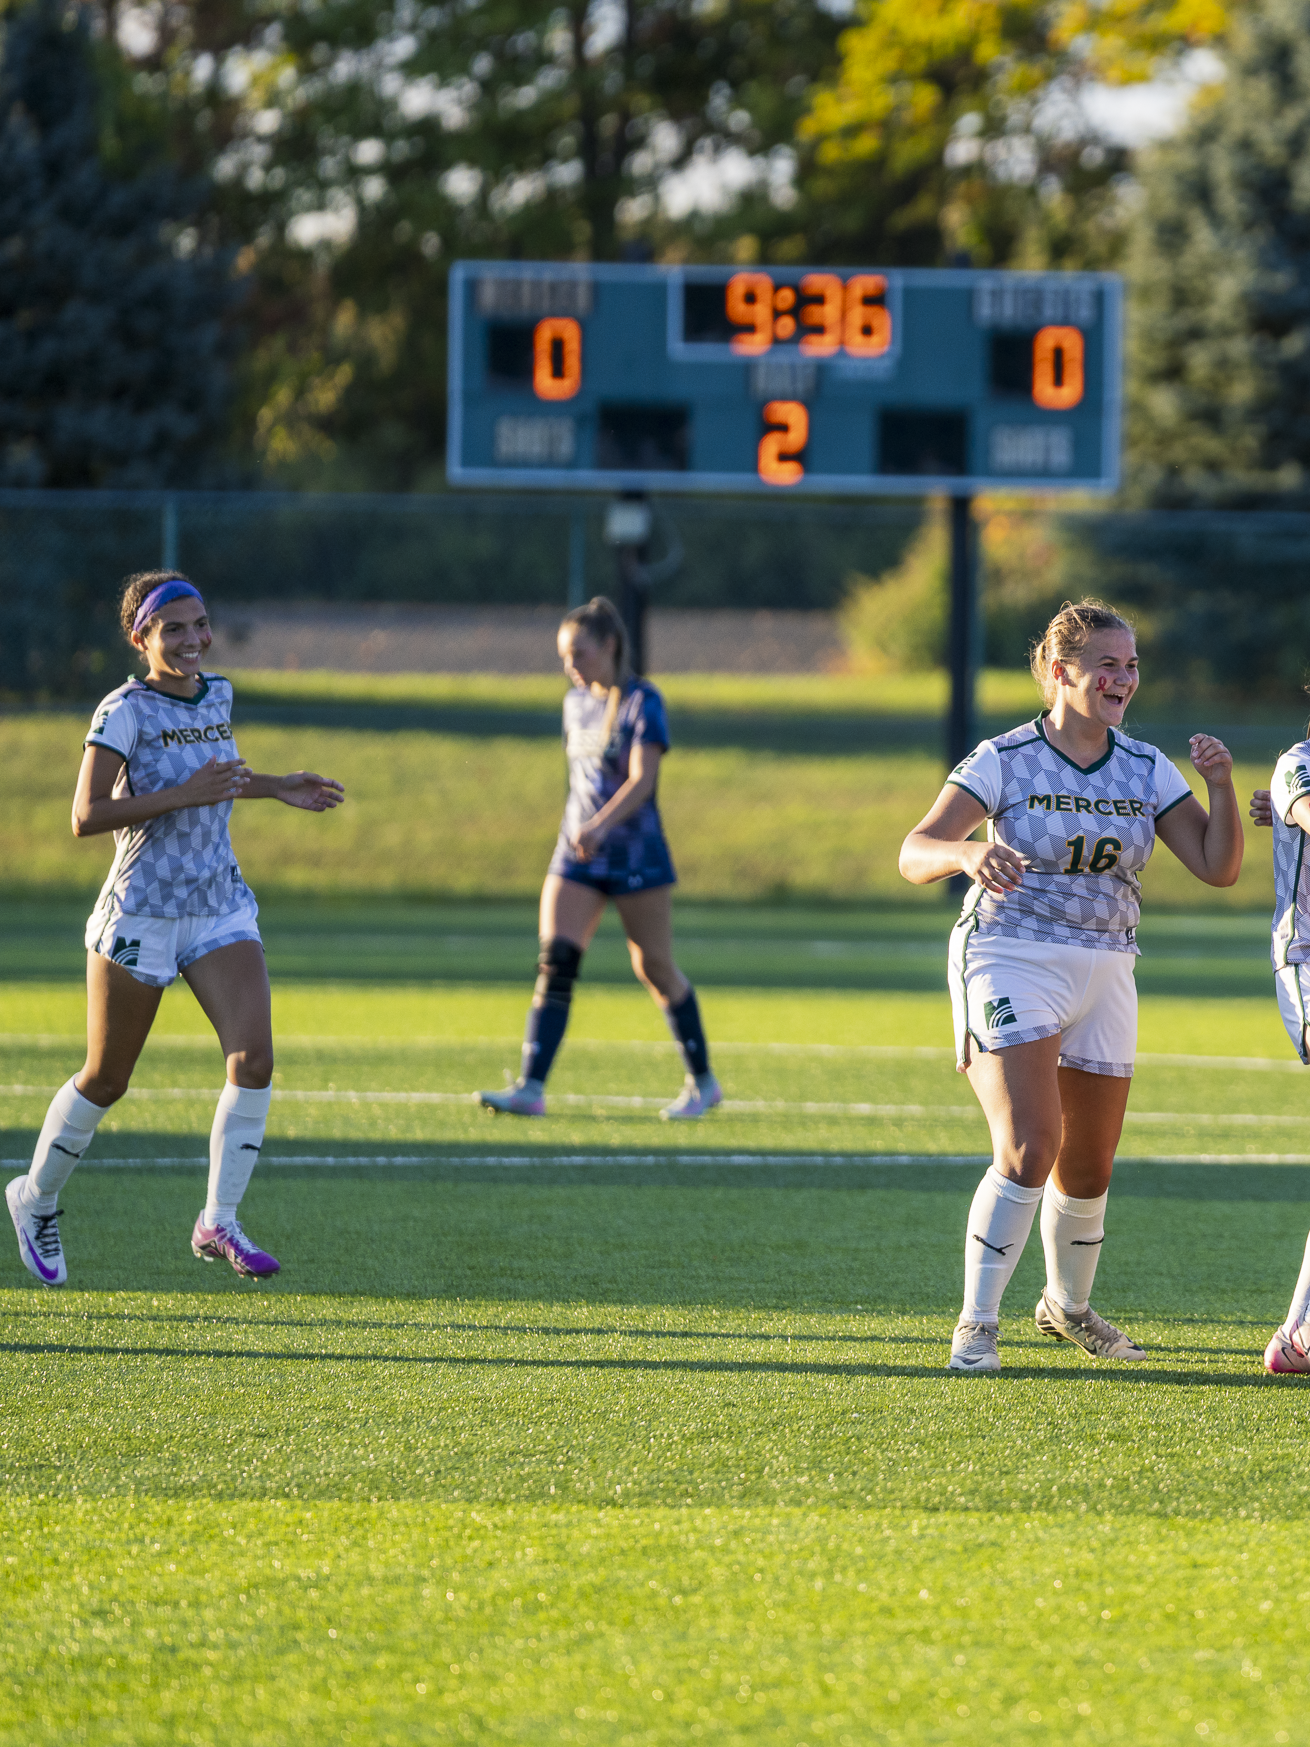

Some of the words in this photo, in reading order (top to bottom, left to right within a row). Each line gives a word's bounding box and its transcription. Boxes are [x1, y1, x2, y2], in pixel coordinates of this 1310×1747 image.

[726, 272, 892, 358] 9:36
[533, 317, 582, 400] 0
[1032, 325, 1084, 411] 0
[758, 400, 809, 487] 2
[1028, 793, 1146, 818] MERCER
[1063, 834, 1123, 875] 16
